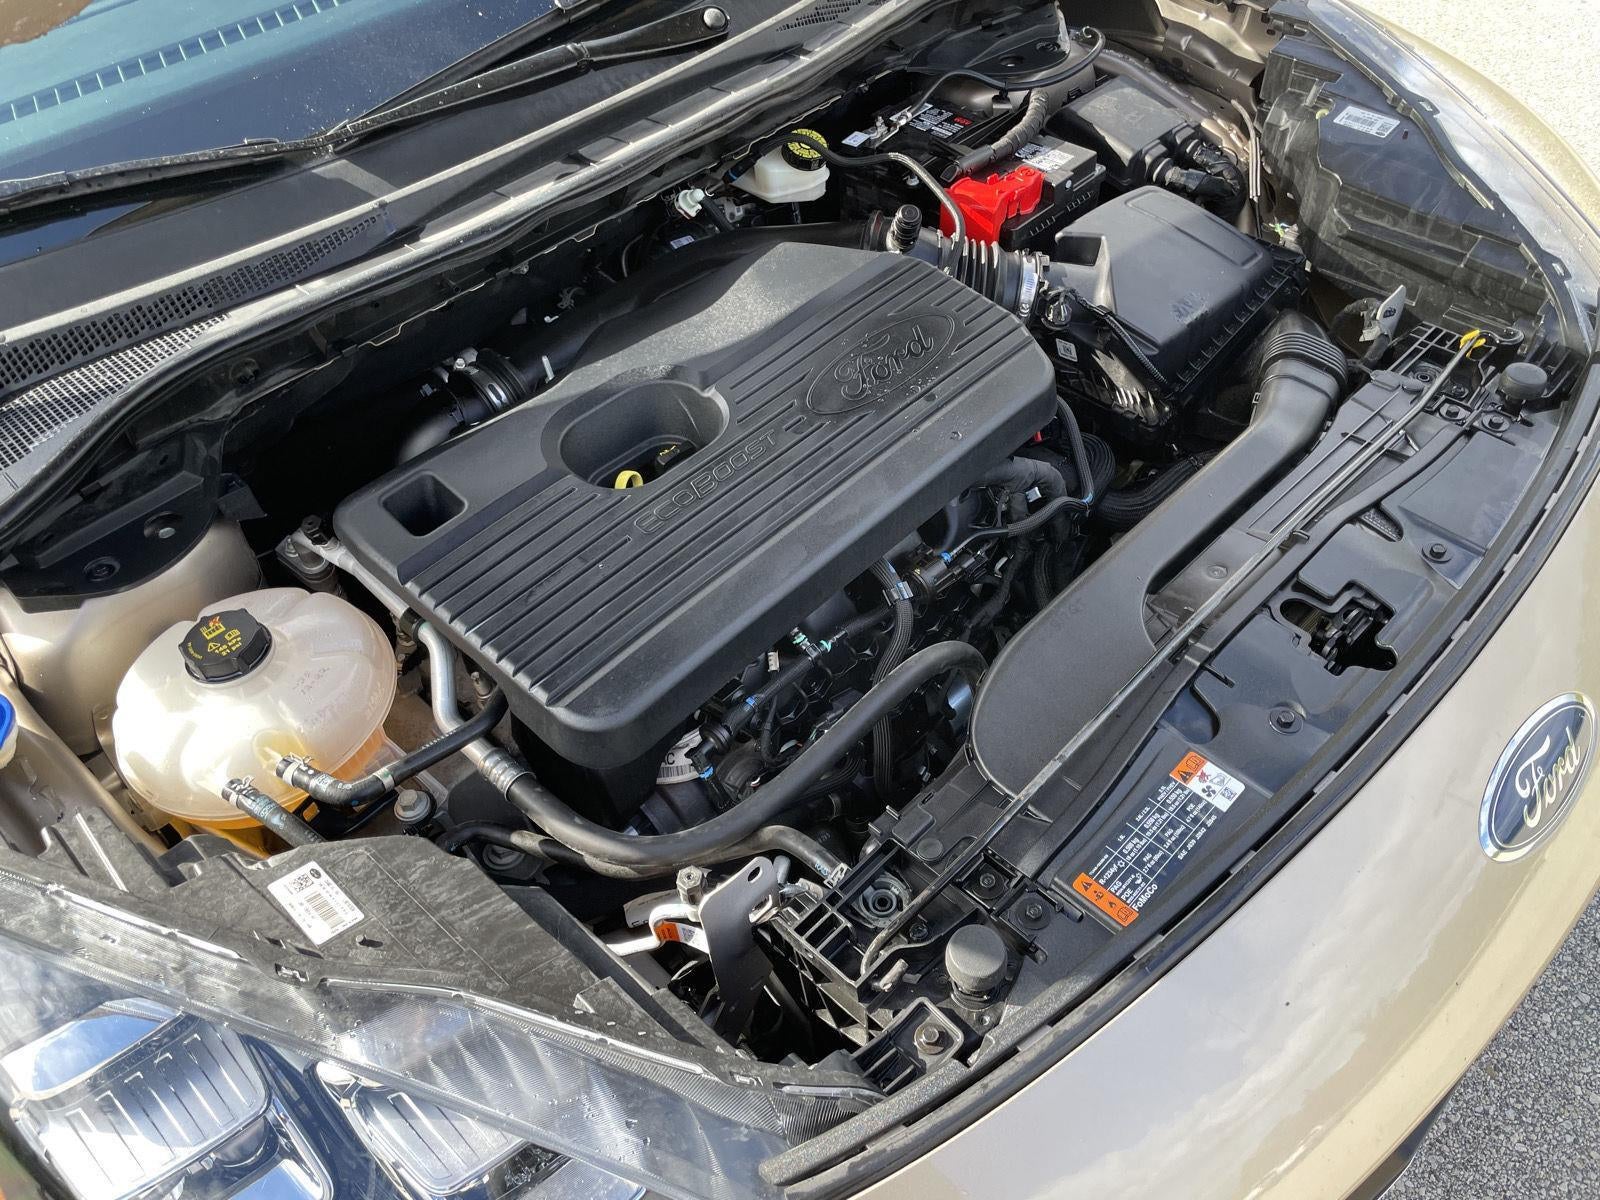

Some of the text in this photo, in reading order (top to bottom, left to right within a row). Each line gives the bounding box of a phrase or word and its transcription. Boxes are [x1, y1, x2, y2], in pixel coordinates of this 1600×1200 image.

[834, 325, 935, 401] Ford
[634, 429, 778, 534] ECOBOOST
[1515, 726, 1581, 828] Ford
[1099, 864, 1120, 886] R-1234yf
[1110, 881, 1123, 893] PAG
[1121, 888, 1133, 901] POE
[1132, 882, 1159, 911] FoMoCo
